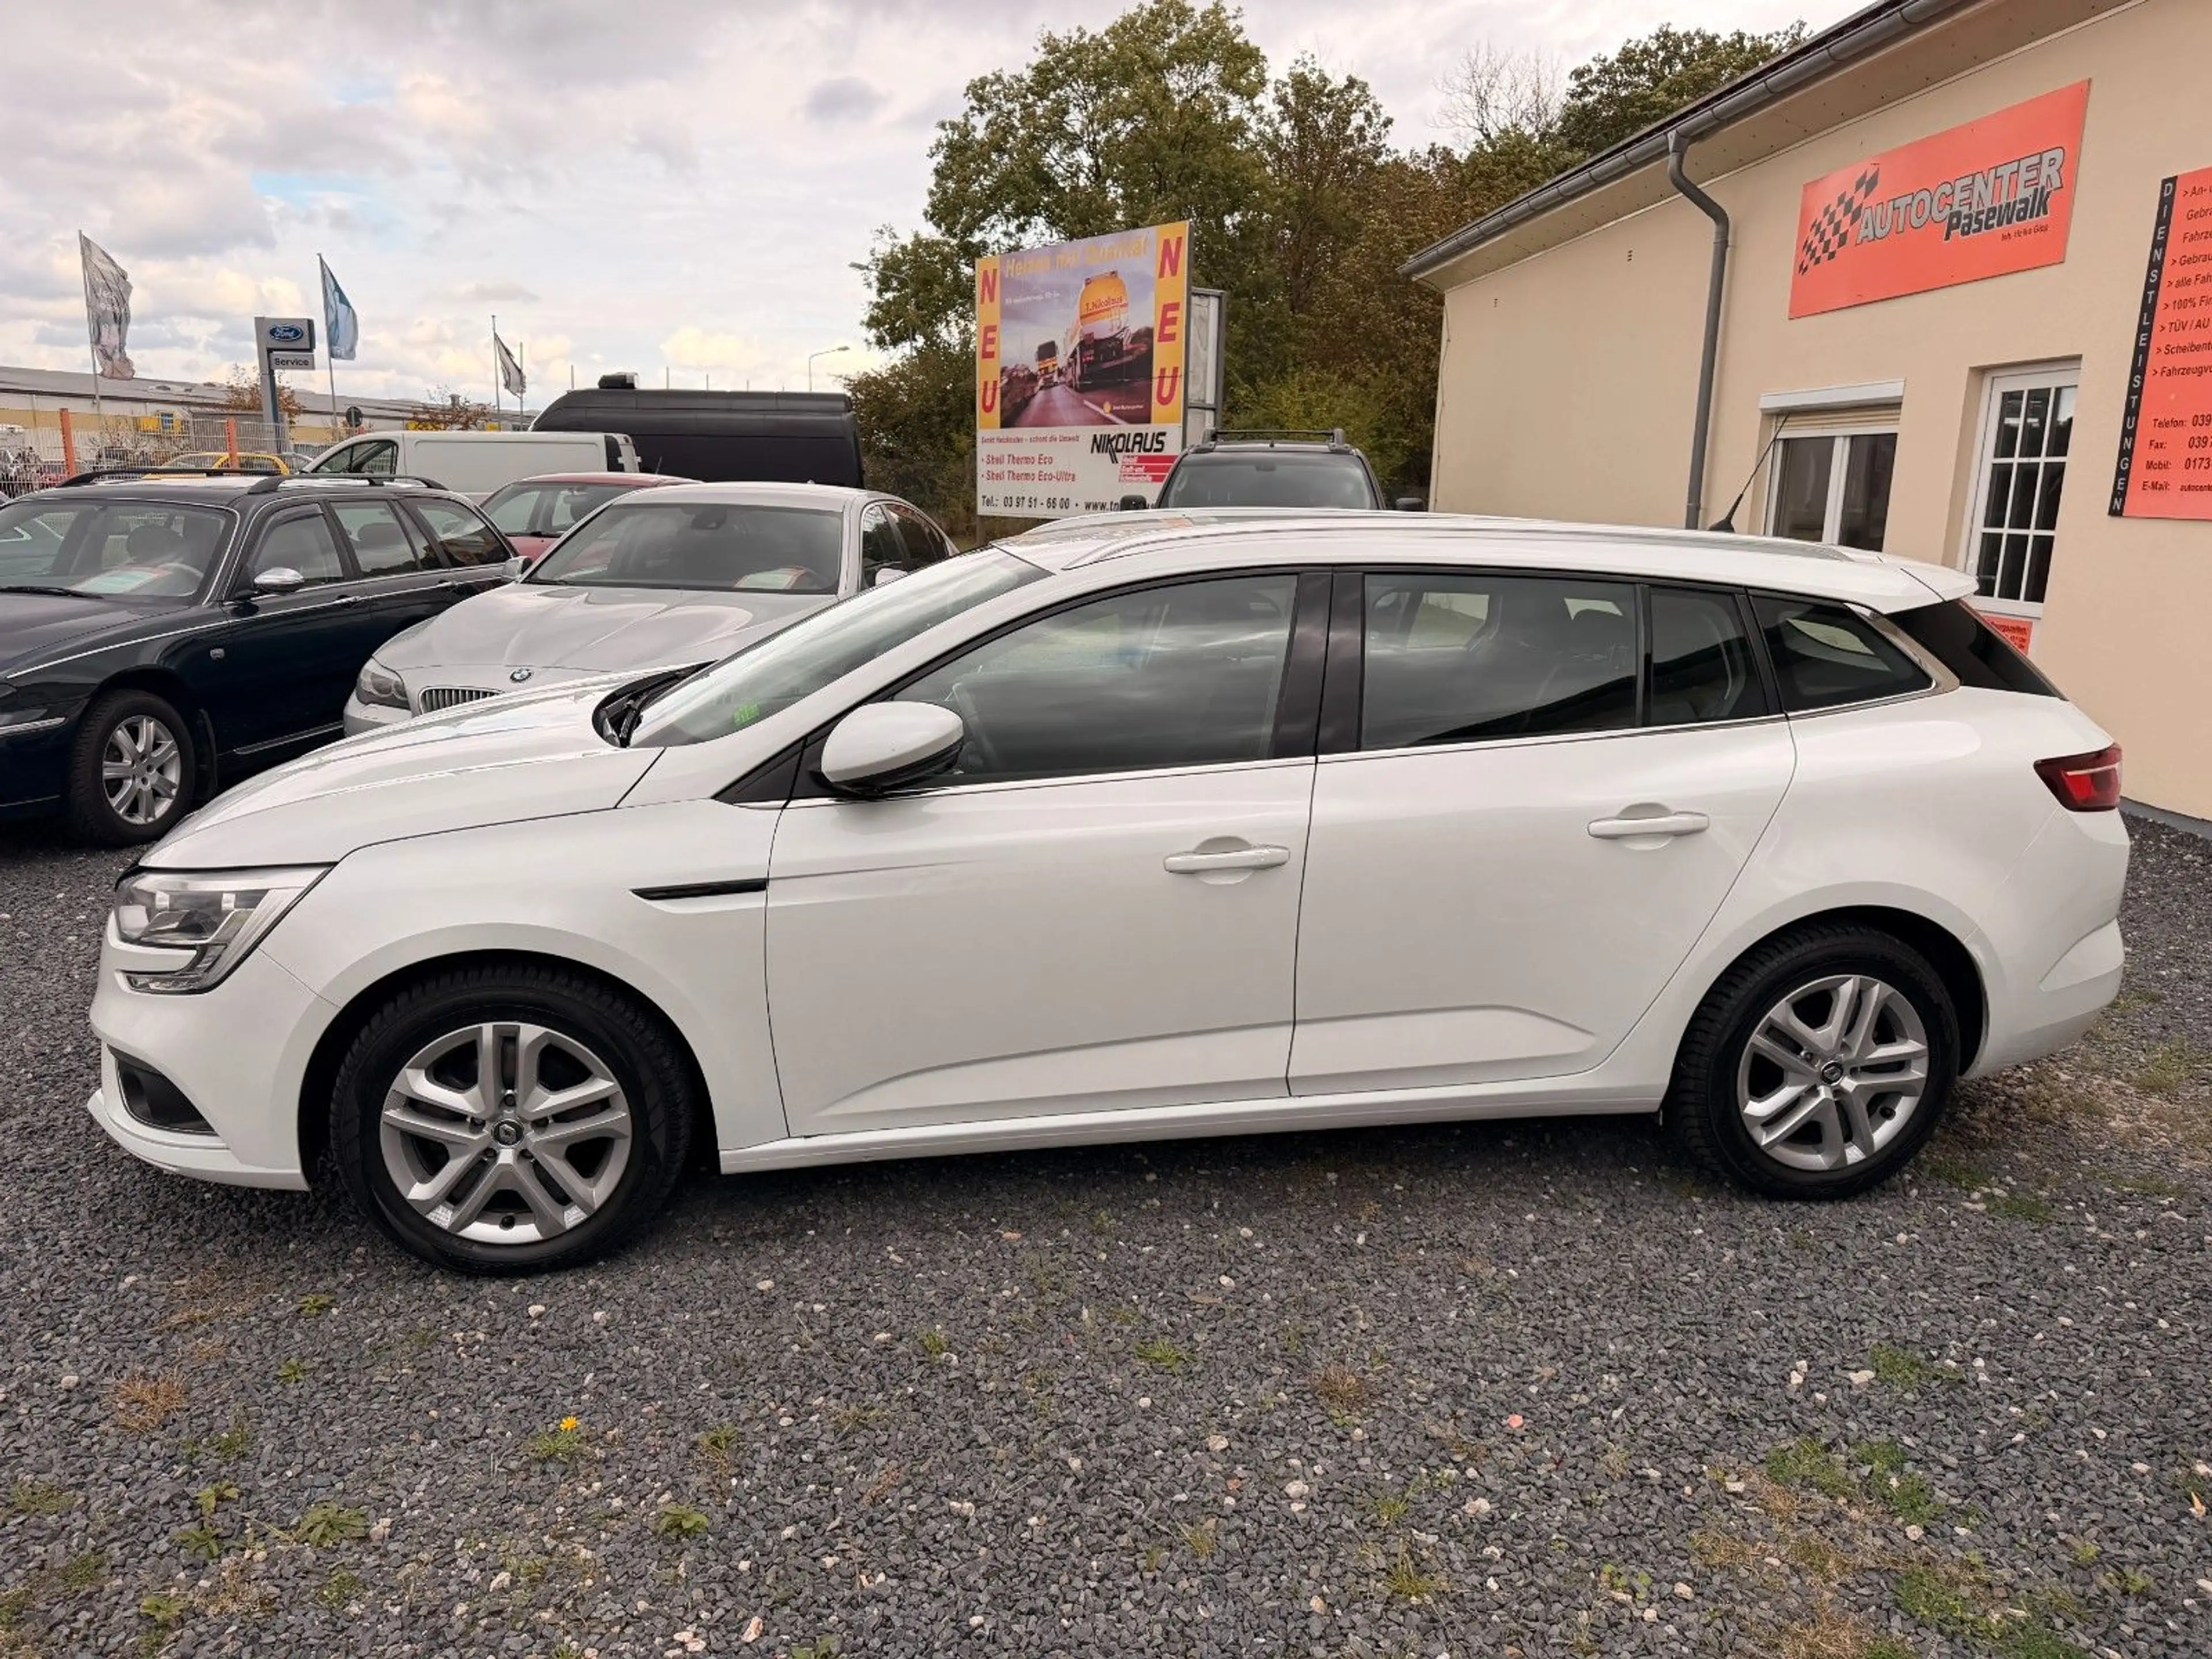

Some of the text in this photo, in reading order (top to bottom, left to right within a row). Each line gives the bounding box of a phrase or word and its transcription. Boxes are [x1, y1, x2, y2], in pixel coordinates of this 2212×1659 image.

[1855, 146, 2065, 247] AUTOCENTER
[1944, 187, 2052, 242] Pasewalk
[2175, 276, 2191, 288] alle
[2173, 297, 2196, 310] 100%
[1156, 236, 1183, 406] NEU
[2169, 319, 2188, 332] TÜV
[2194, 318, 2210, 329] AU
[274, 327, 296, 337] Ford
[980, 268, 997, 413] NEU
[2112, 182, 2173, 511] DIENSTLEISTUNGEN
[274, 358, 310, 366] Service
[2153, 418, 2187, 428] Telefon:
[1090, 432, 1167, 463] NIKOLAUS
[2148, 440, 2166, 449] Fax:
[986, 454, 1053, 464] Shell Thermo Eco
[2146, 457, 2210, 469] Mobil: 0173
[986, 470, 1005, 480] Shell
[1007, 470, 1035, 481] Thermo
[2142, 481, 2170, 491] E-Mail:
[982, 495, 999, 507] Tel.:
[1003, 496, 1013, 507] 03
[1016, 497, 1025, 507] 97
[1028, 497, 1037, 508] 51
